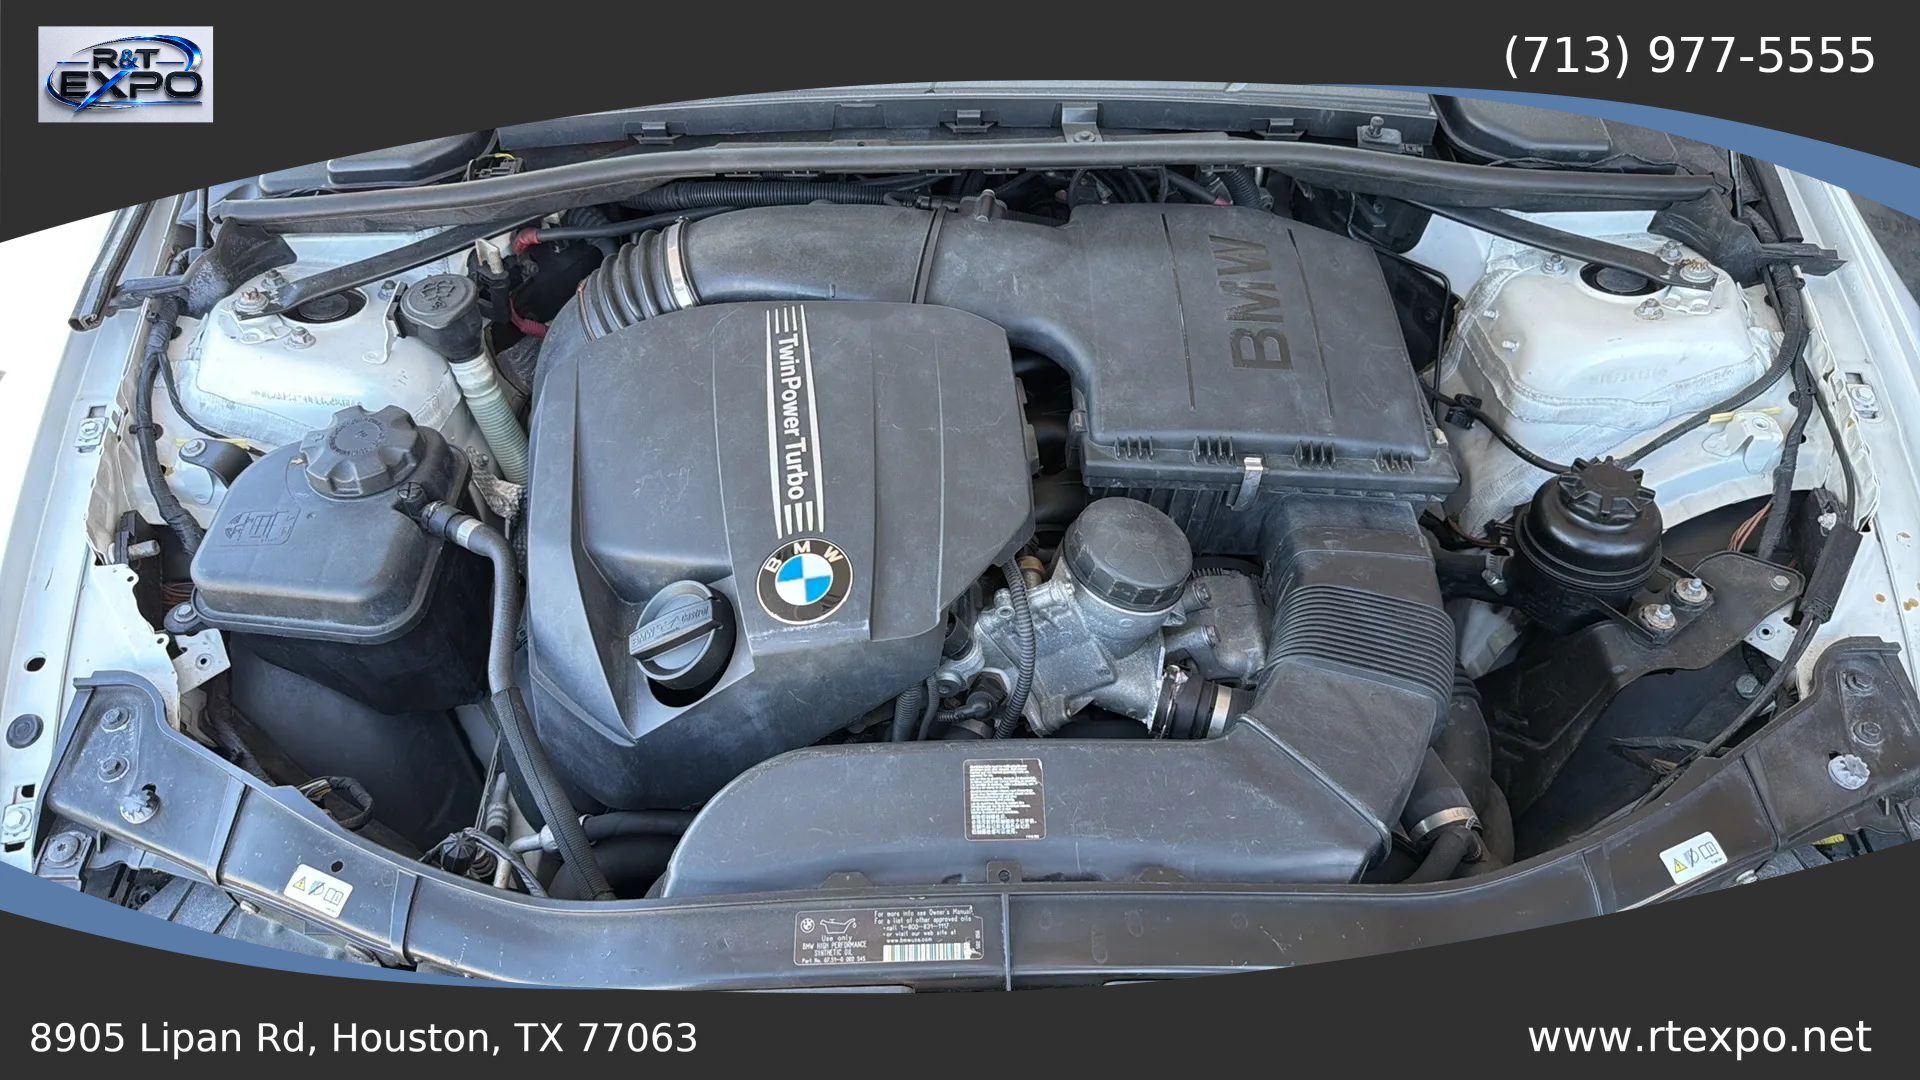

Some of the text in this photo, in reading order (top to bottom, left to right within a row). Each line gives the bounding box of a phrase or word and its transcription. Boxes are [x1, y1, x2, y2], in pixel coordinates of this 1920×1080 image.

[1213, 234, 1294, 371] BMW
[764, 540, 843, 574] BMW
[802, 942, 815, 950] BMW
[831, 940, 867, 949] PERFORMANCE
[837, 934, 853, 942] only
